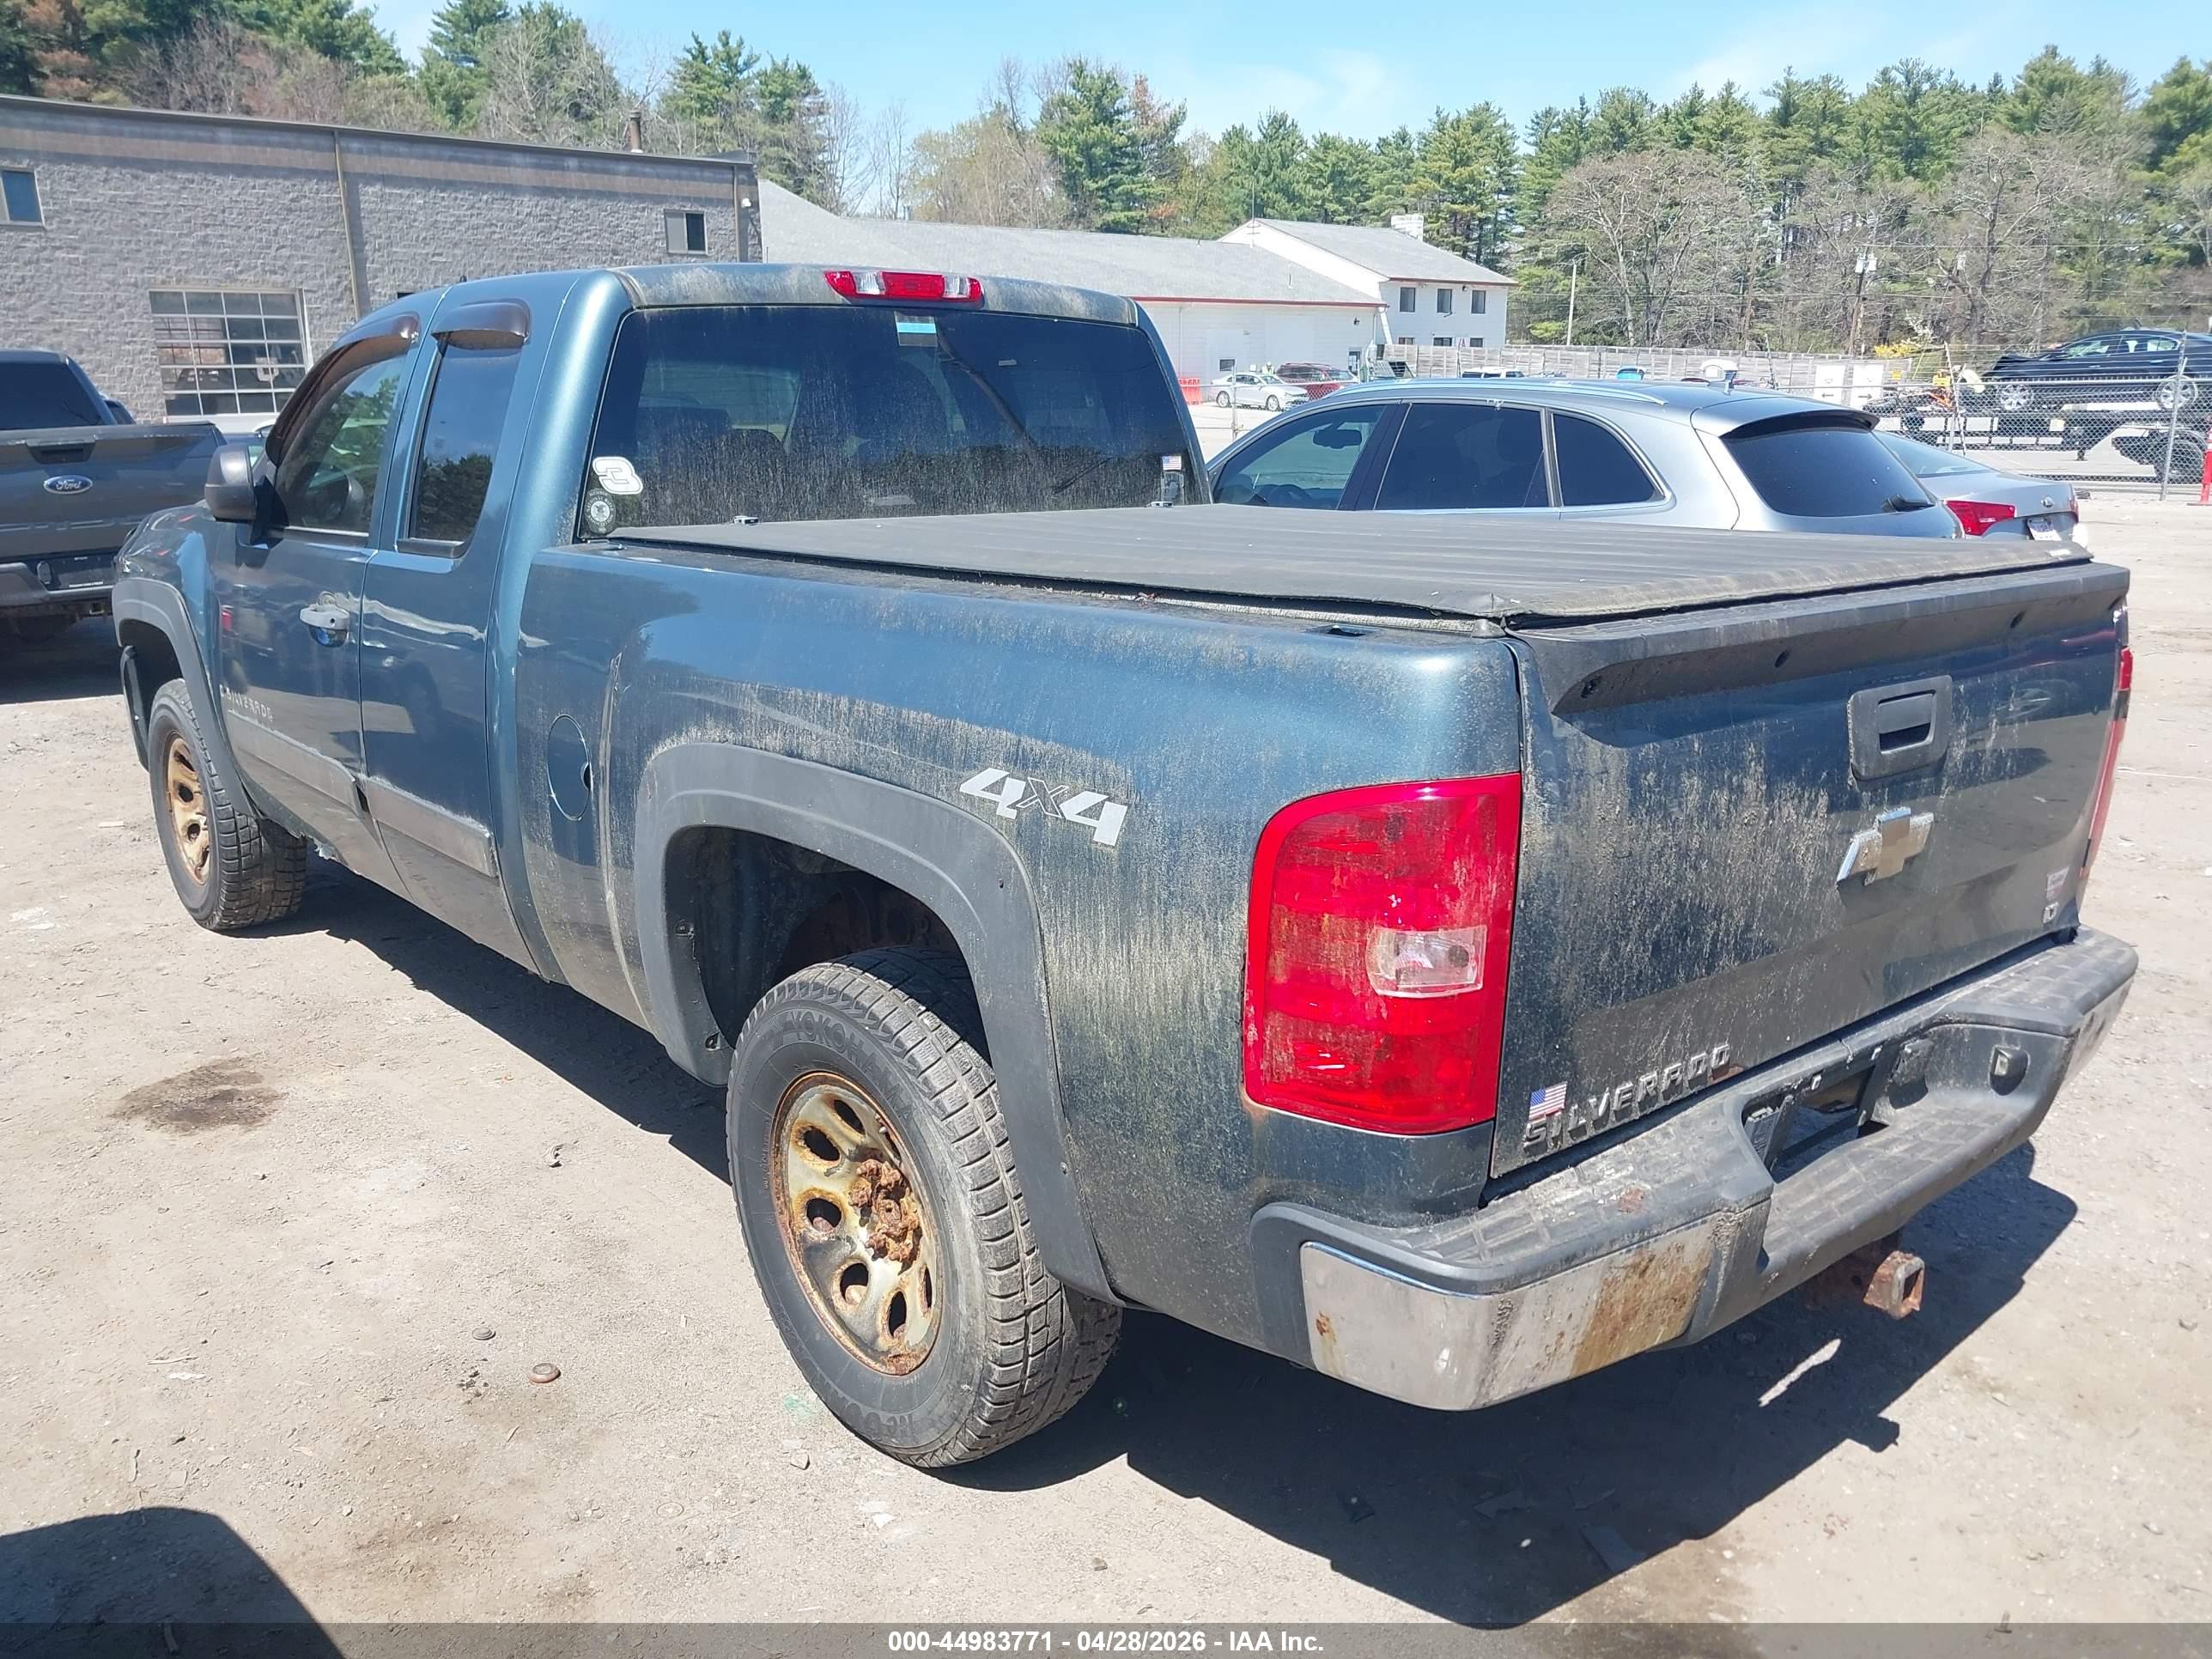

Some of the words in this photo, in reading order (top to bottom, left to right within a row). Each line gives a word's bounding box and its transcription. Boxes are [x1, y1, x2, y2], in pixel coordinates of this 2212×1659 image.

[56, 478, 82, 490] Ford
[592, 456, 643, 495] 3
[789, 1011, 913, 1121] YOKOHAMA
[1522, 1042, 1731, 1147] SILVERADO
